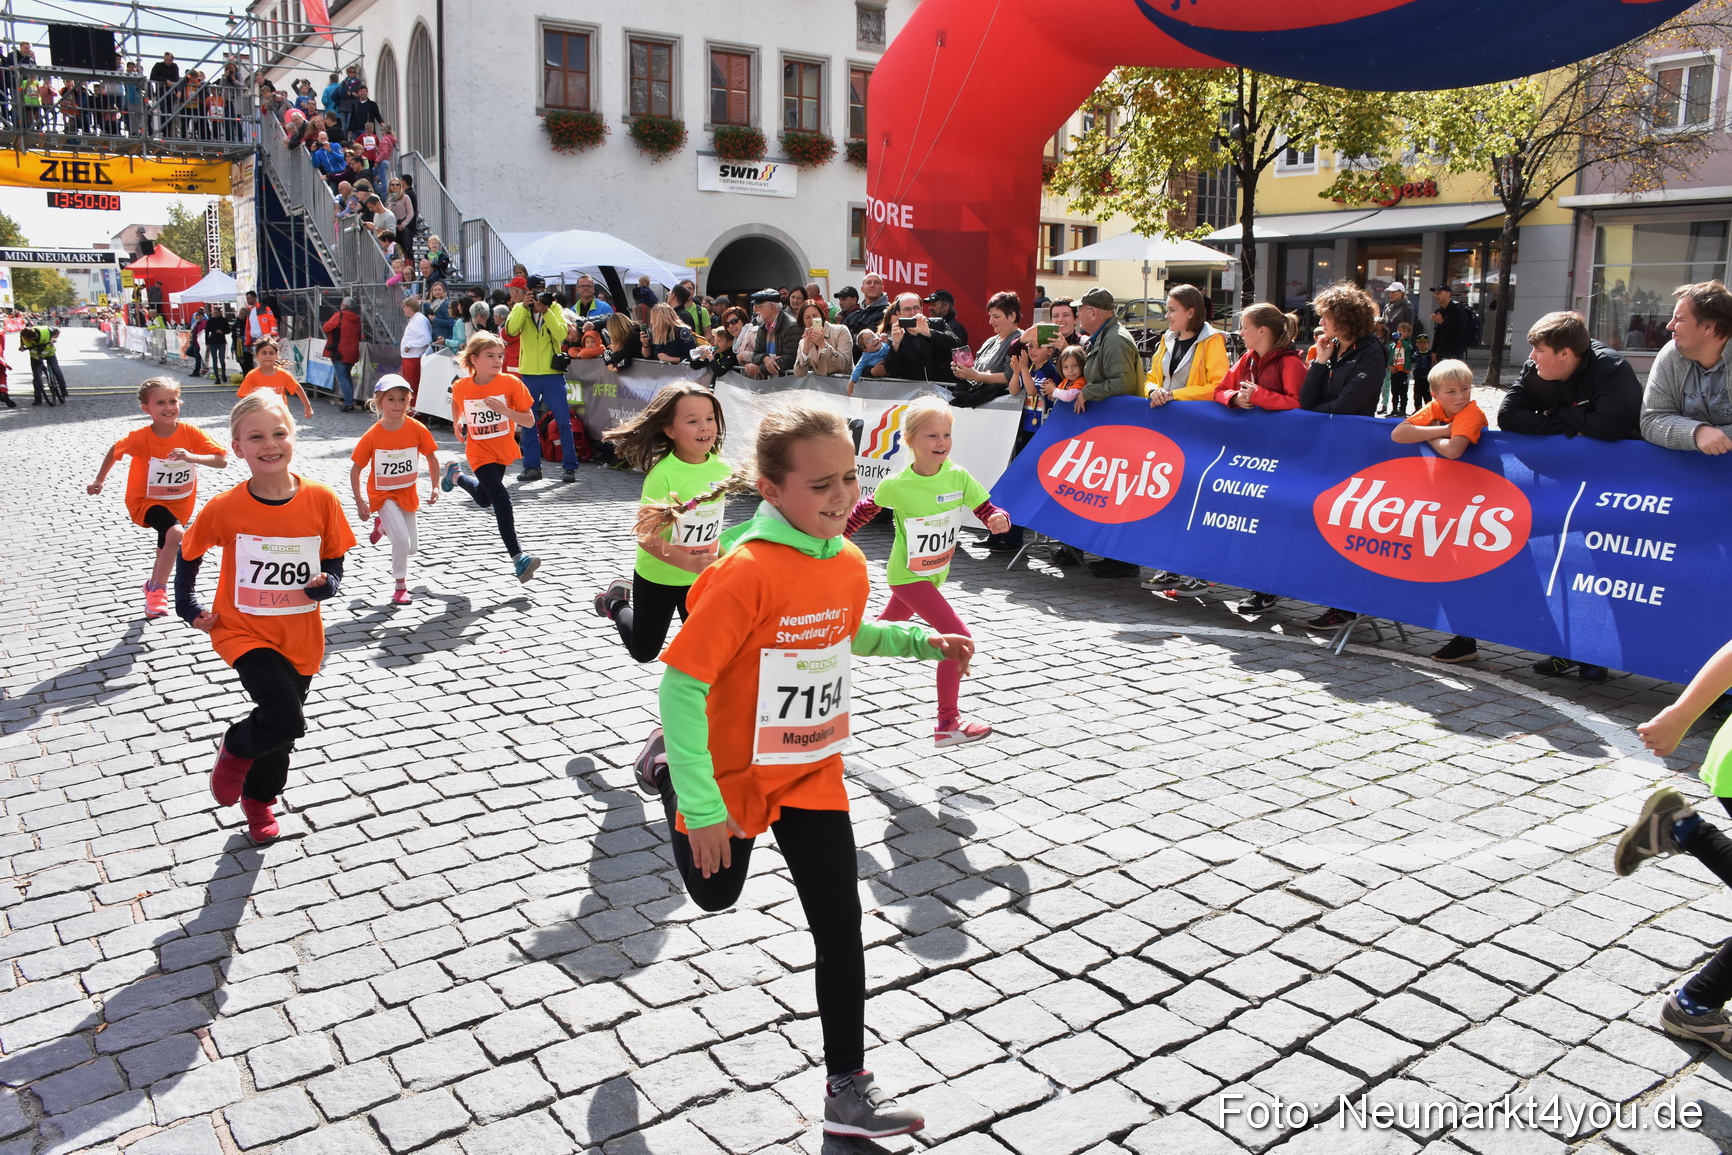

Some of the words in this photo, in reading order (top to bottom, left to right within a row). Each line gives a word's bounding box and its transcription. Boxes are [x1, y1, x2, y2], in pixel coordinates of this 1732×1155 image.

[39, 159, 113, 185] ZIEL
[719, 164, 759, 180] swn
[4, 249, 34, 261] MINI
[36, 250, 106, 263] NEUMARKT.
[470, 410, 502, 425] 7399
[473, 424, 500, 435] LUZIE
[381, 459, 413, 475] 7258
[1047, 438, 1173, 506] Hervis
[1228, 454, 1279, 473] STORE
[156, 469, 190, 484] 7125
[1054, 484, 1109, 509] SPORTS
[1212, 478, 1268, 499] ONLINE
[1595, 491, 1674, 515] STORE
[1202, 511, 1260, 534] MOBILE
[1326, 477, 1515, 557] Hervis
[683, 519, 719, 543] 7122
[916, 526, 955, 553] 7014
[270, 544, 301, 552] BOCK
[1344, 534, 1413, 561] SPORTS
[1584, 531, 1677, 562] ONLINE
[249, 560, 311, 586] 7269
[259, 591, 290, 606] EVA
[1571, 573, 1666, 606] MOBILE
[775, 624, 831, 644] Stadtlauf
[776, 675, 843, 720] 7154
[782, 725, 835, 746] Magdalena
